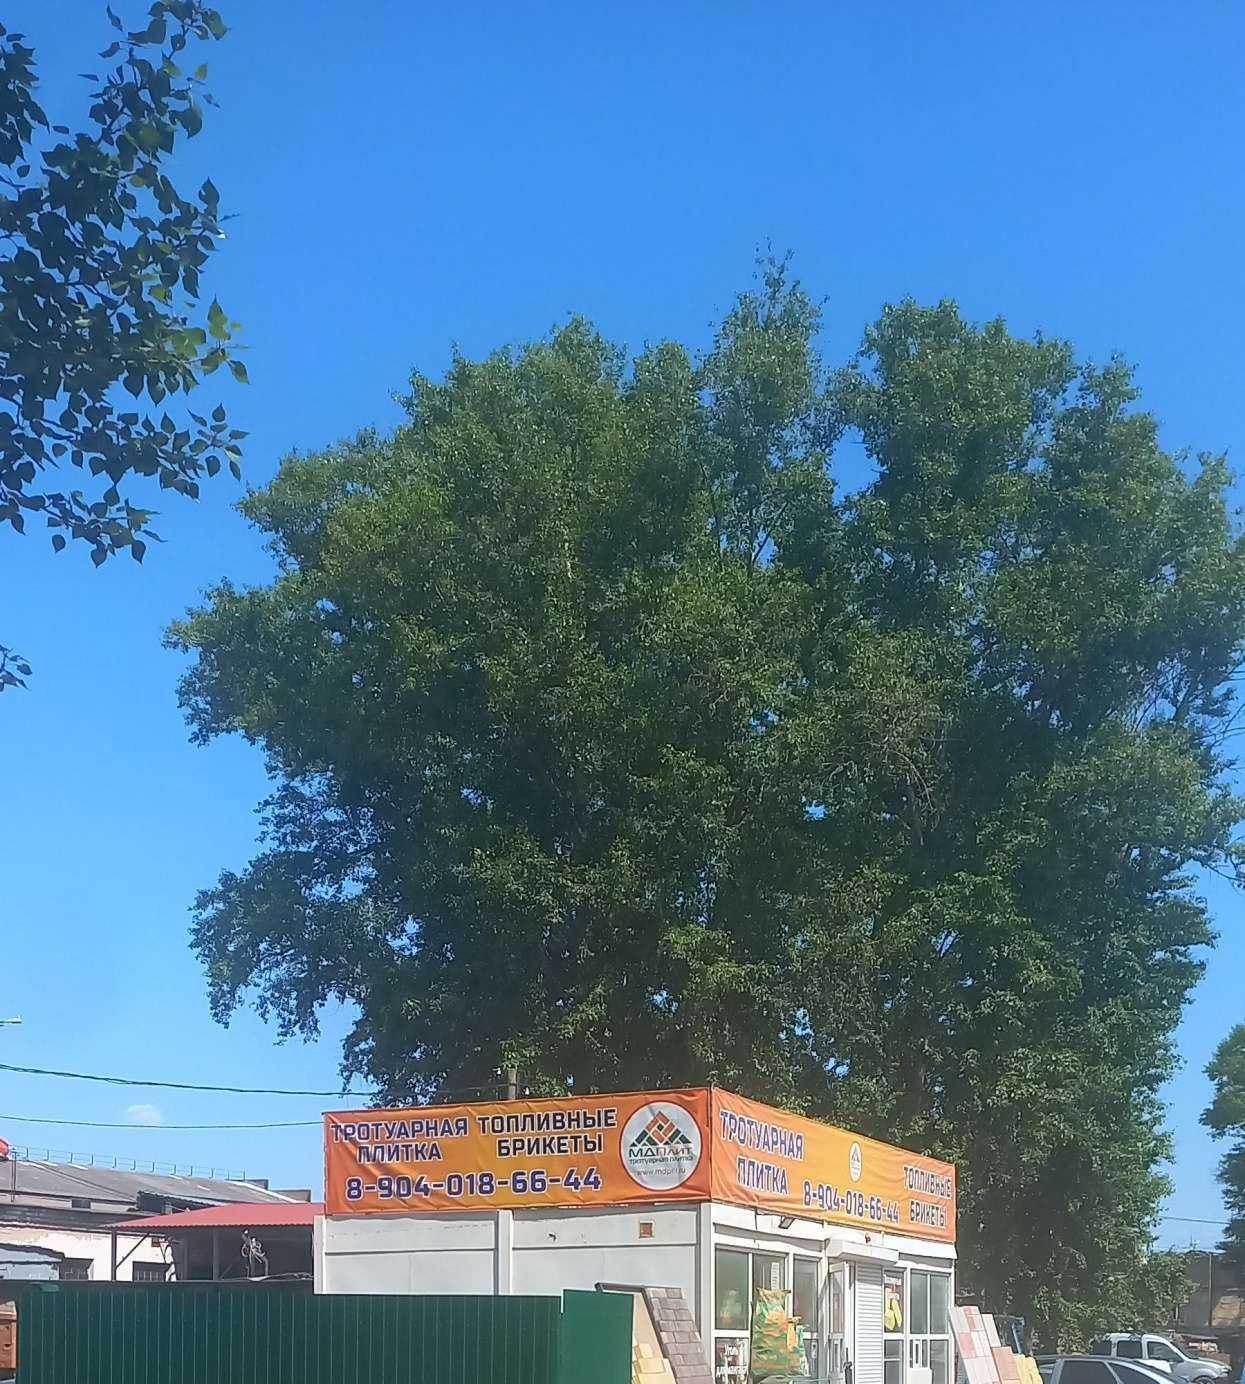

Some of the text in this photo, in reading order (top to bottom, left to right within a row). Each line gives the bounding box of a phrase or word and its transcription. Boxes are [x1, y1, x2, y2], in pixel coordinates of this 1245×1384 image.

[331, 1108, 618, 1142] ТРОТУАРНАЯ ТОПЛИВНЫЕ
[720, 1110, 804, 1161] ТРОТУАРНАЯ
[357, 1134, 603, 1163] ПЛИТКА БРИКЕТЫ
[346, 1167, 602, 1200] 8-904-018-66-44
[736, 1156, 788, 1195] ПЛИТКА
[903, 1166, 952, 1198] ТОПЛИВНЫЕ
[803, 1179, 899, 1224] 8-904-018-66-44
[909, 1200, 947, 1229] БРИКЕТЫ
